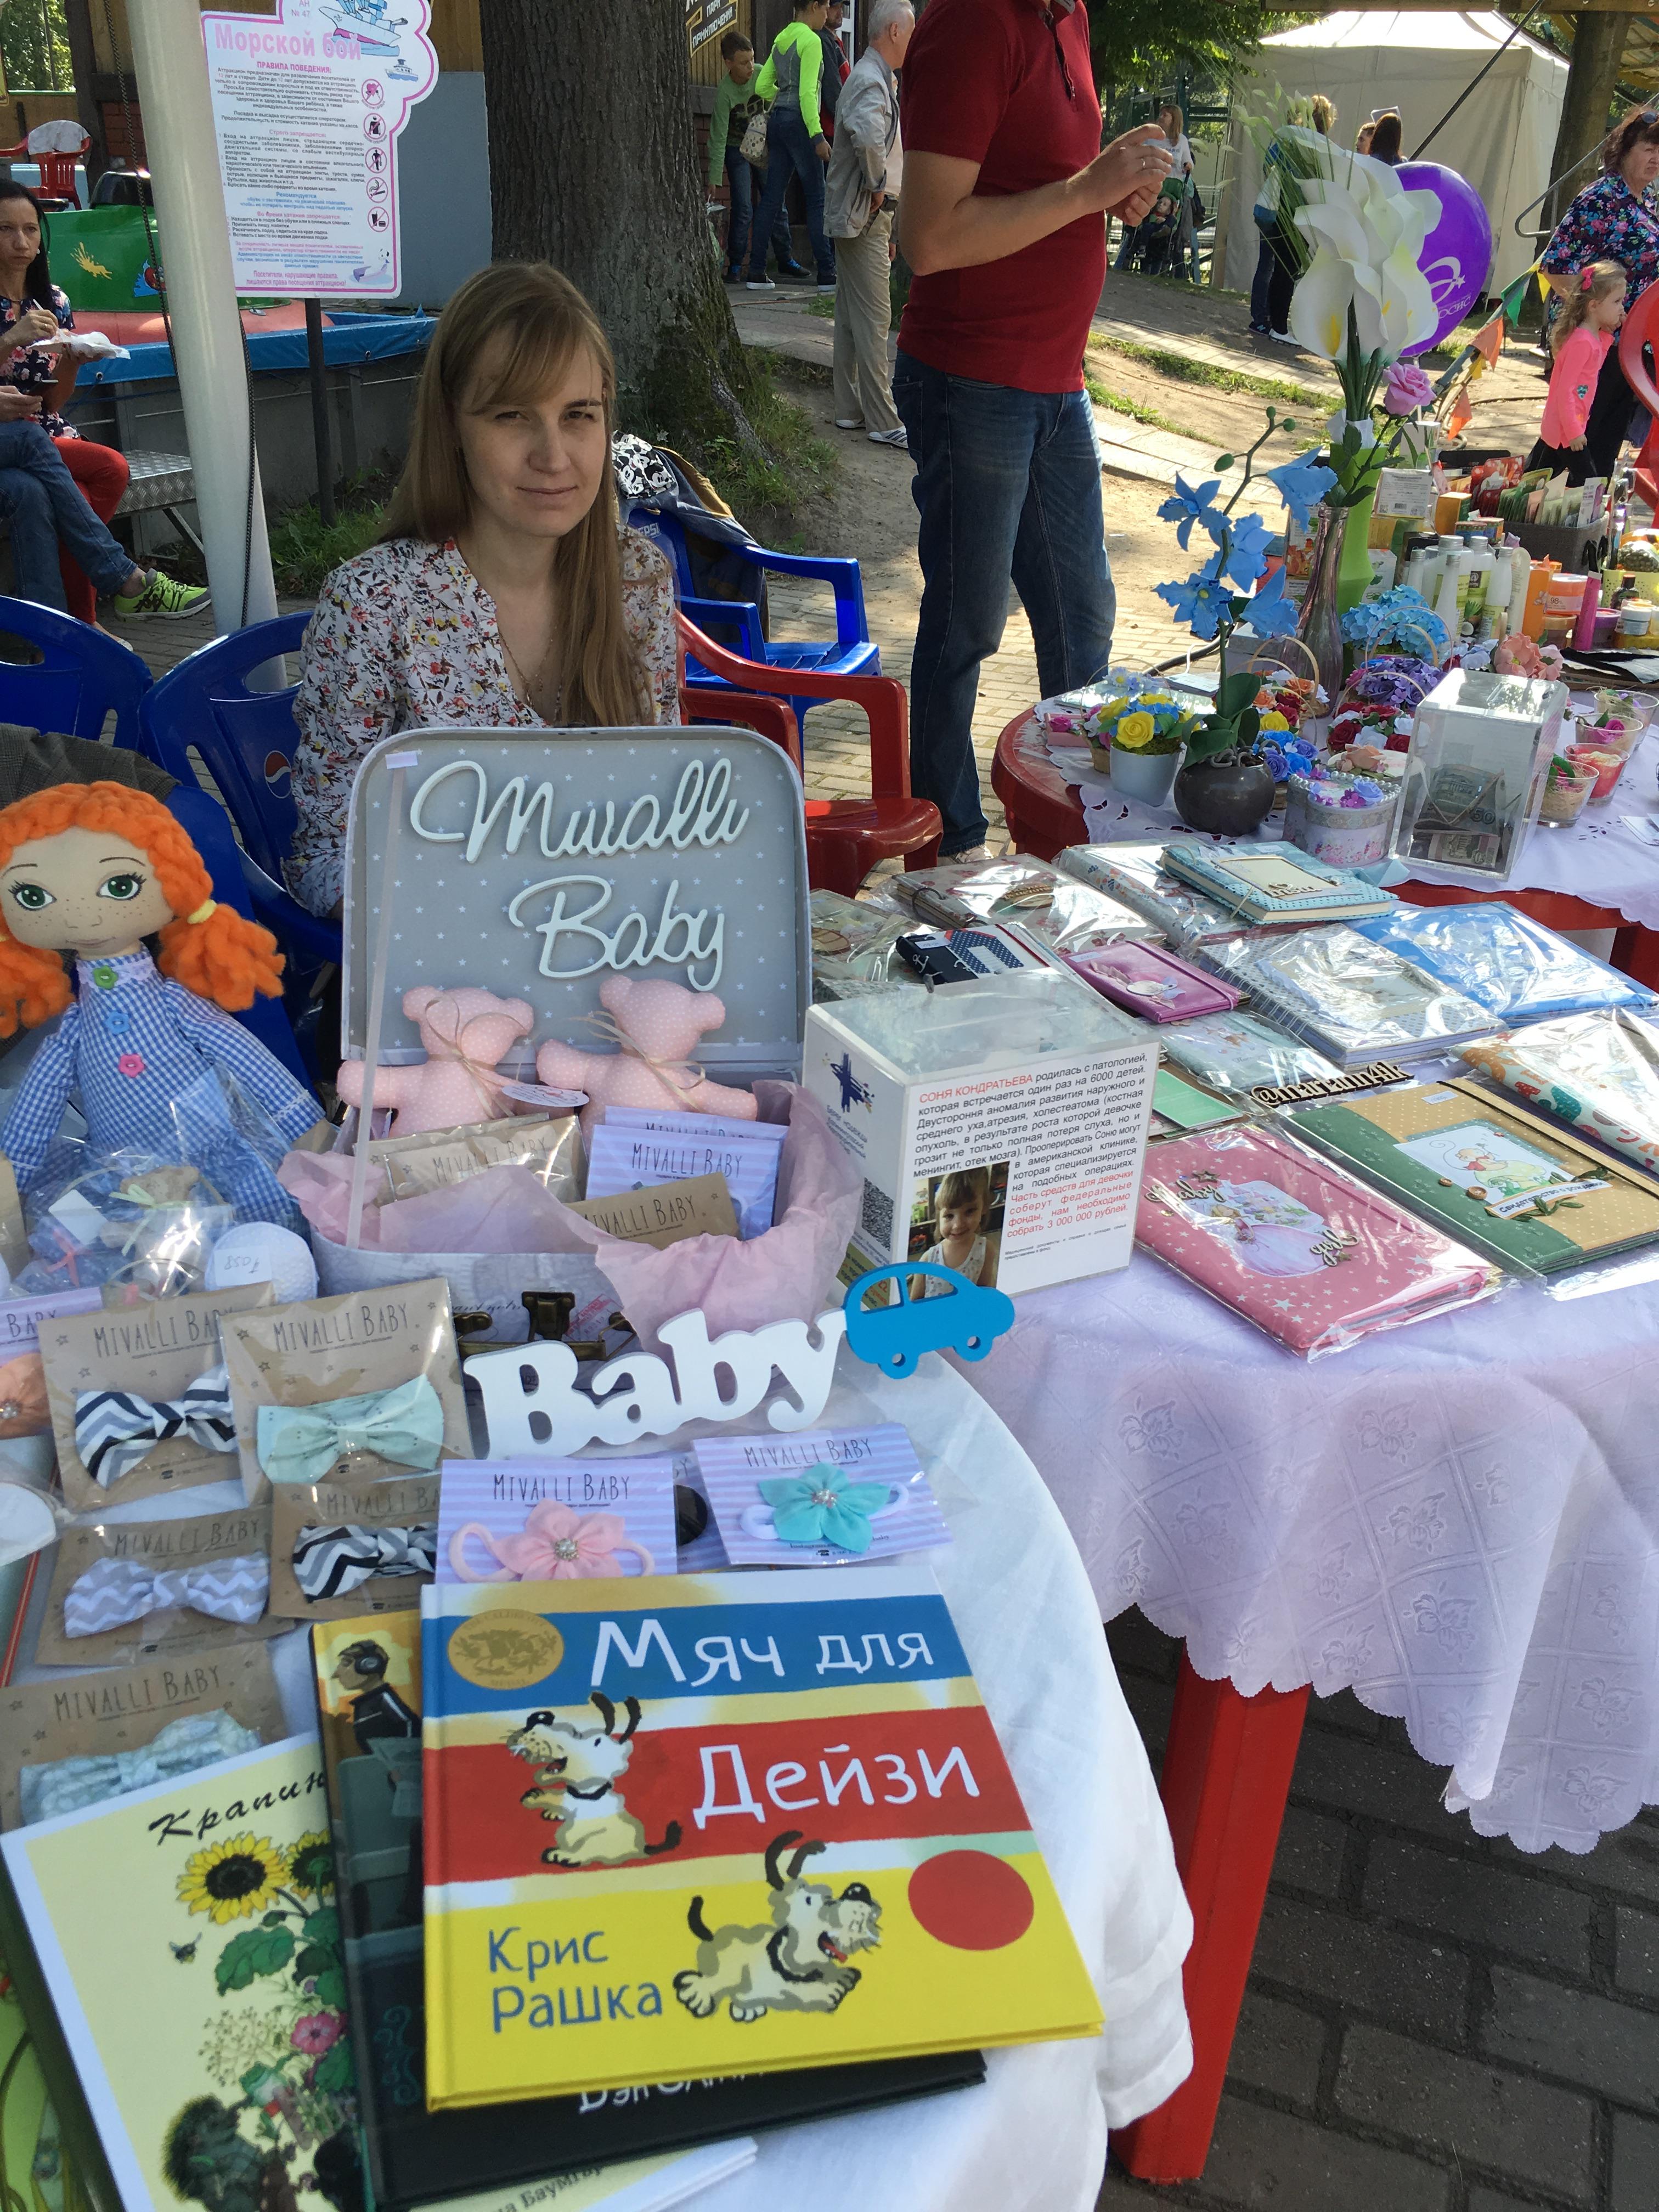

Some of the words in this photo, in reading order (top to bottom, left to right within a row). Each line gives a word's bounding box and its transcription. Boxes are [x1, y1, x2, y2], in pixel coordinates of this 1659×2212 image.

[215, 24, 315, 58] Морской
[323, 31, 362, 60] бой
[257, 61, 289, 70] ПРАВИЛА
[290, 64, 332, 74] ПОВЕДЕНИЯ:
[410, 758, 749, 864] Mivalli
[509, 874, 726, 991] Baby
[918, 1102, 960, 1116] которая
[963, 1090, 1024, 1108] встречается
[1028, 1085, 1052, 1096] один
[1055, 1080, 1071, 1092] раз
[1075, 1077, 1087, 1086] на
[1090, 1070, 1114, 1083] 6000
[1116, 1065, 1146, 1079] детей.
[919, 1088, 953, 1103] СОНЯ
[955, 1074, 1033, 1096] КОНДРАТЬЕВА
[1035, 1067, 1082, 1084] родилась
[1092, 1053, 1147, 1071] патологией,
[915, 1139, 959, 1153] опухоль,
[974, 1125, 1028, 1143] результате
[1031, 1118, 1059, 1132] роста
[1063, 1108, 1101, 1124] которой
[1103, 1102, 1142, 1116] девочке
[916, 1126, 963, 1142] среднего
[967, 1113, 1028, 1133] уха,атрезия,
[1033, 1098, 1099, 1118] холестеатома
[1103, 1090, 1143, 1105] (костная
[917, 1109, 983, 1131] Двустороння
[986, 1099, 1036, 1115] аномалия
[1039, 1090, 1084, 1107] развития
[1086, 1080, 1136, 1095] наружного
[631, 1142, 696, 1175] MIVALLI
[704, 1149, 743, 1178] BABY
[913, 1161, 962, 1177] менингит,
[965, 1156, 987, 1167] отек
[989, 1148, 1022, 1162] мозга).
[1025, 1135, 1093, 1155] Прооперировать
[1094, 1129, 1117, 1139] Соню
[1119, 1124, 1142, 1135] могут
[914, 1153, 947, 1166] грозит
[952, 1149, 964, 1158] не
[969, 1141, 1003, 1154] только
[1007, 1133, 1042, 1146] полная
[1047, 1125, 1080, 1138] потеря
[1084, 1119, 1113, 1131] слуха,
[1013, 1166, 1050, 1180] которая
[1054, 1148, 1137, 1171] специализируется
[1028, 1144, 1093, 1166] американской
[1099, 1137, 1137, 1150] клинике,
[1009, 1199, 1052, 1215] соберут
[1060, 1182, 1132, 1204] федеральные
[1011, 1192, 1039, 1203] Часть
[1040, 1183, 1077, 1198] средств
[1078, 1178, 1096, 1190] для
[1097, 1171, 1133, 1186] девочки
[1012, 1183, 1024, 1192] на
[1031, 1172, 1077, 1187] подобных
[1085, 1160, 1132, 1176] операциях.
[653, 1195, 696, 1226] BABY
[1007, 1224, 1044, 1238] собрать
[1047, 1220, 1053, 1229] 3
[1056, 1215, 1073, 1227] 000
[1075, 1211, 1092, 1222] 000
[1094, 1203, 1128, 1220] рублей.
[1008, 1214, 1043, 1228] фонды,
[1051, 1207, 1069, 1216] нам
[1076, 1193, 1131, 1211] необходимо
[94, 1316, 178, 1358] MIVALLI
[185, 1307, 233, 1341] BA
[273, 1311, 359, 1352] MIVALLI
[362, 1302, 409, 1338] BABY
[463, 1307, 848, 1460] Baby
[743, 1443, 821, 1468] MIVALLI
[826, 1438, 873, 1462] BABY
[325, 1491, 405, 1516] MIVALLI
[493, 1473, 572, 1501] MIVALLI
[584, 1472, 631, 1501] BABY
[114, 1528, 200, 1556] MIVALLI
[208, 1520, 259, 1546] BABY
[591, 1618, 785, 1689] Мяч
[816, 1632, 934, 1675] для
[53, 1677, 151, 1722] MIVALLI
[164, 1665, 223, 1700] BABY
[692, 1742, 980, 1830] Дейзи
[487, 1926, 609, 1982] Крис
[492, 1979, 663, 2034] Рашка
